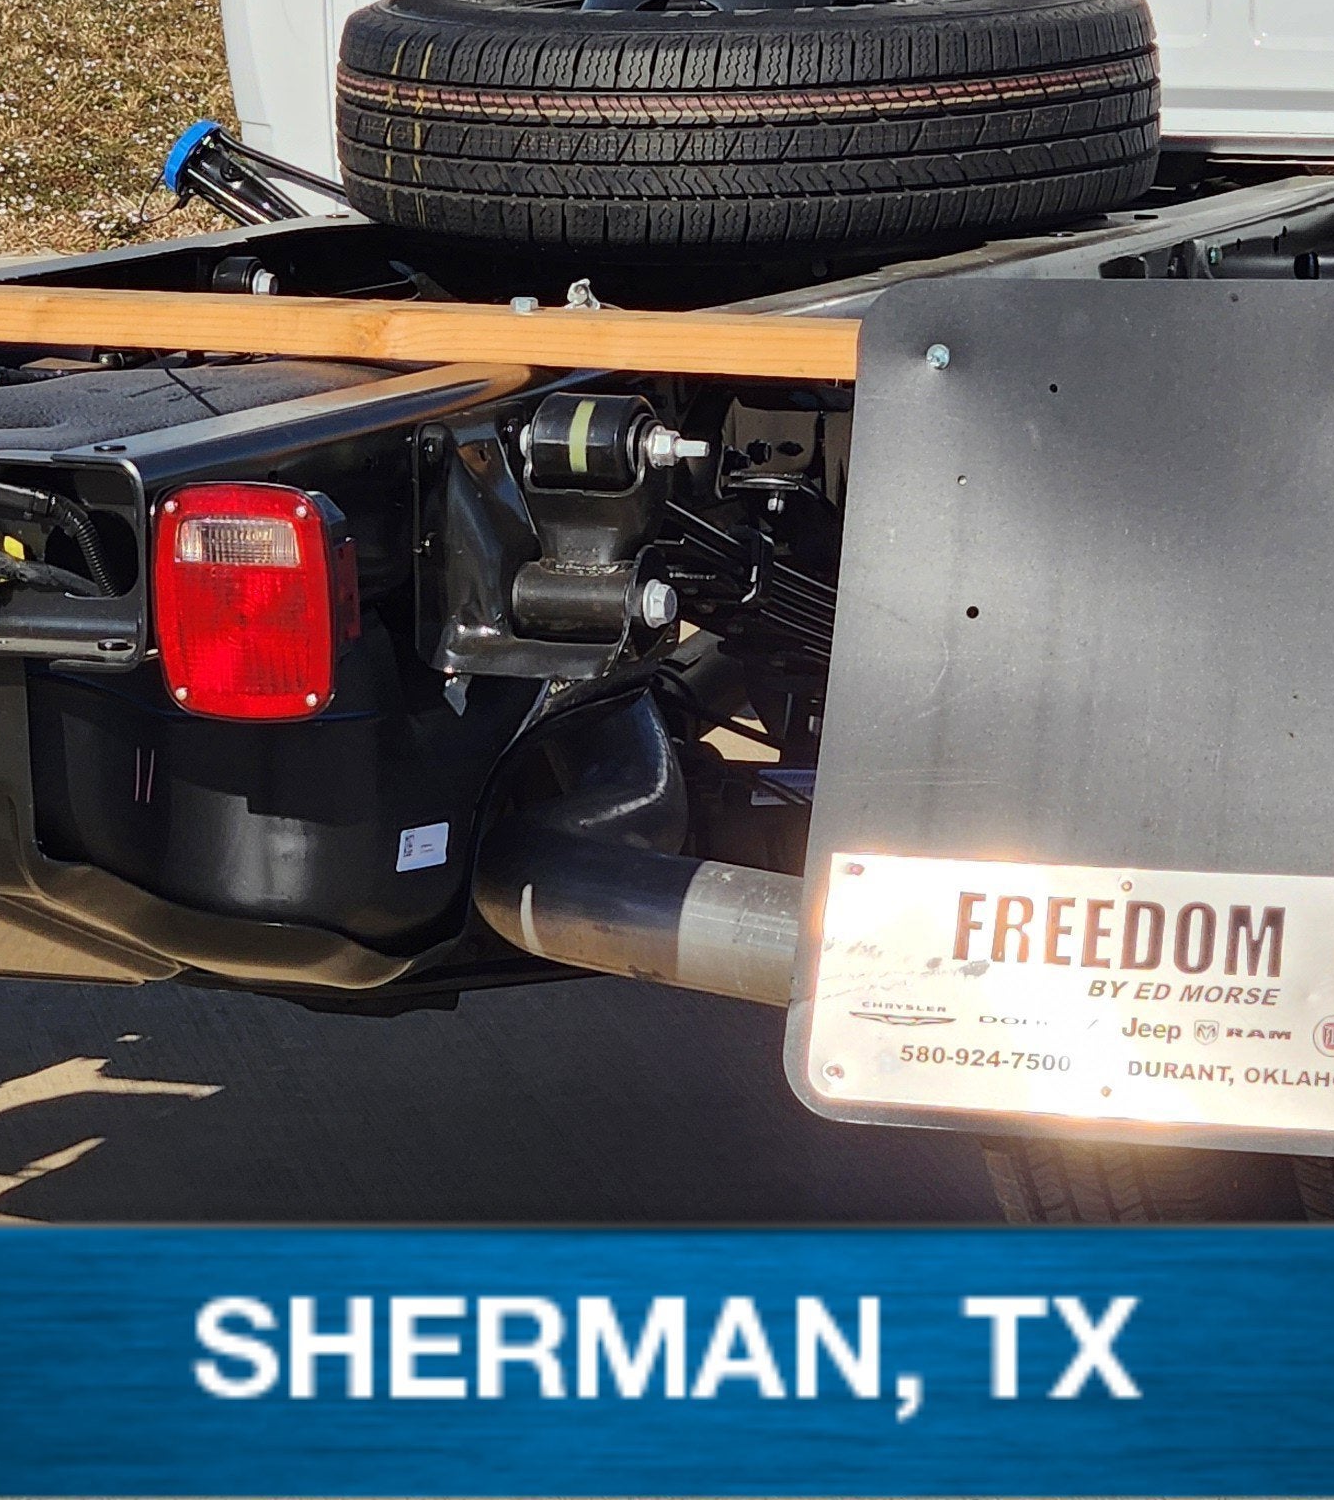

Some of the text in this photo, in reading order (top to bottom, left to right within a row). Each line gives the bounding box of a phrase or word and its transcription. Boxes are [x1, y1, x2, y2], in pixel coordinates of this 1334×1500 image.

[952, 891, 1286, 977] FREEDOM
[1087, 979, 1281, 1006] BY ED MORSE
[861, 1000, 947, 1013] CHRYSLER
[1121, 1017, 1182, 1045] Jeep
[1226, 1026, 1292, 1041] RAM
[899, 1045, 1071, 1072] 580-924-7500
[1127, 1059, 1235, 1086] DURANT,
